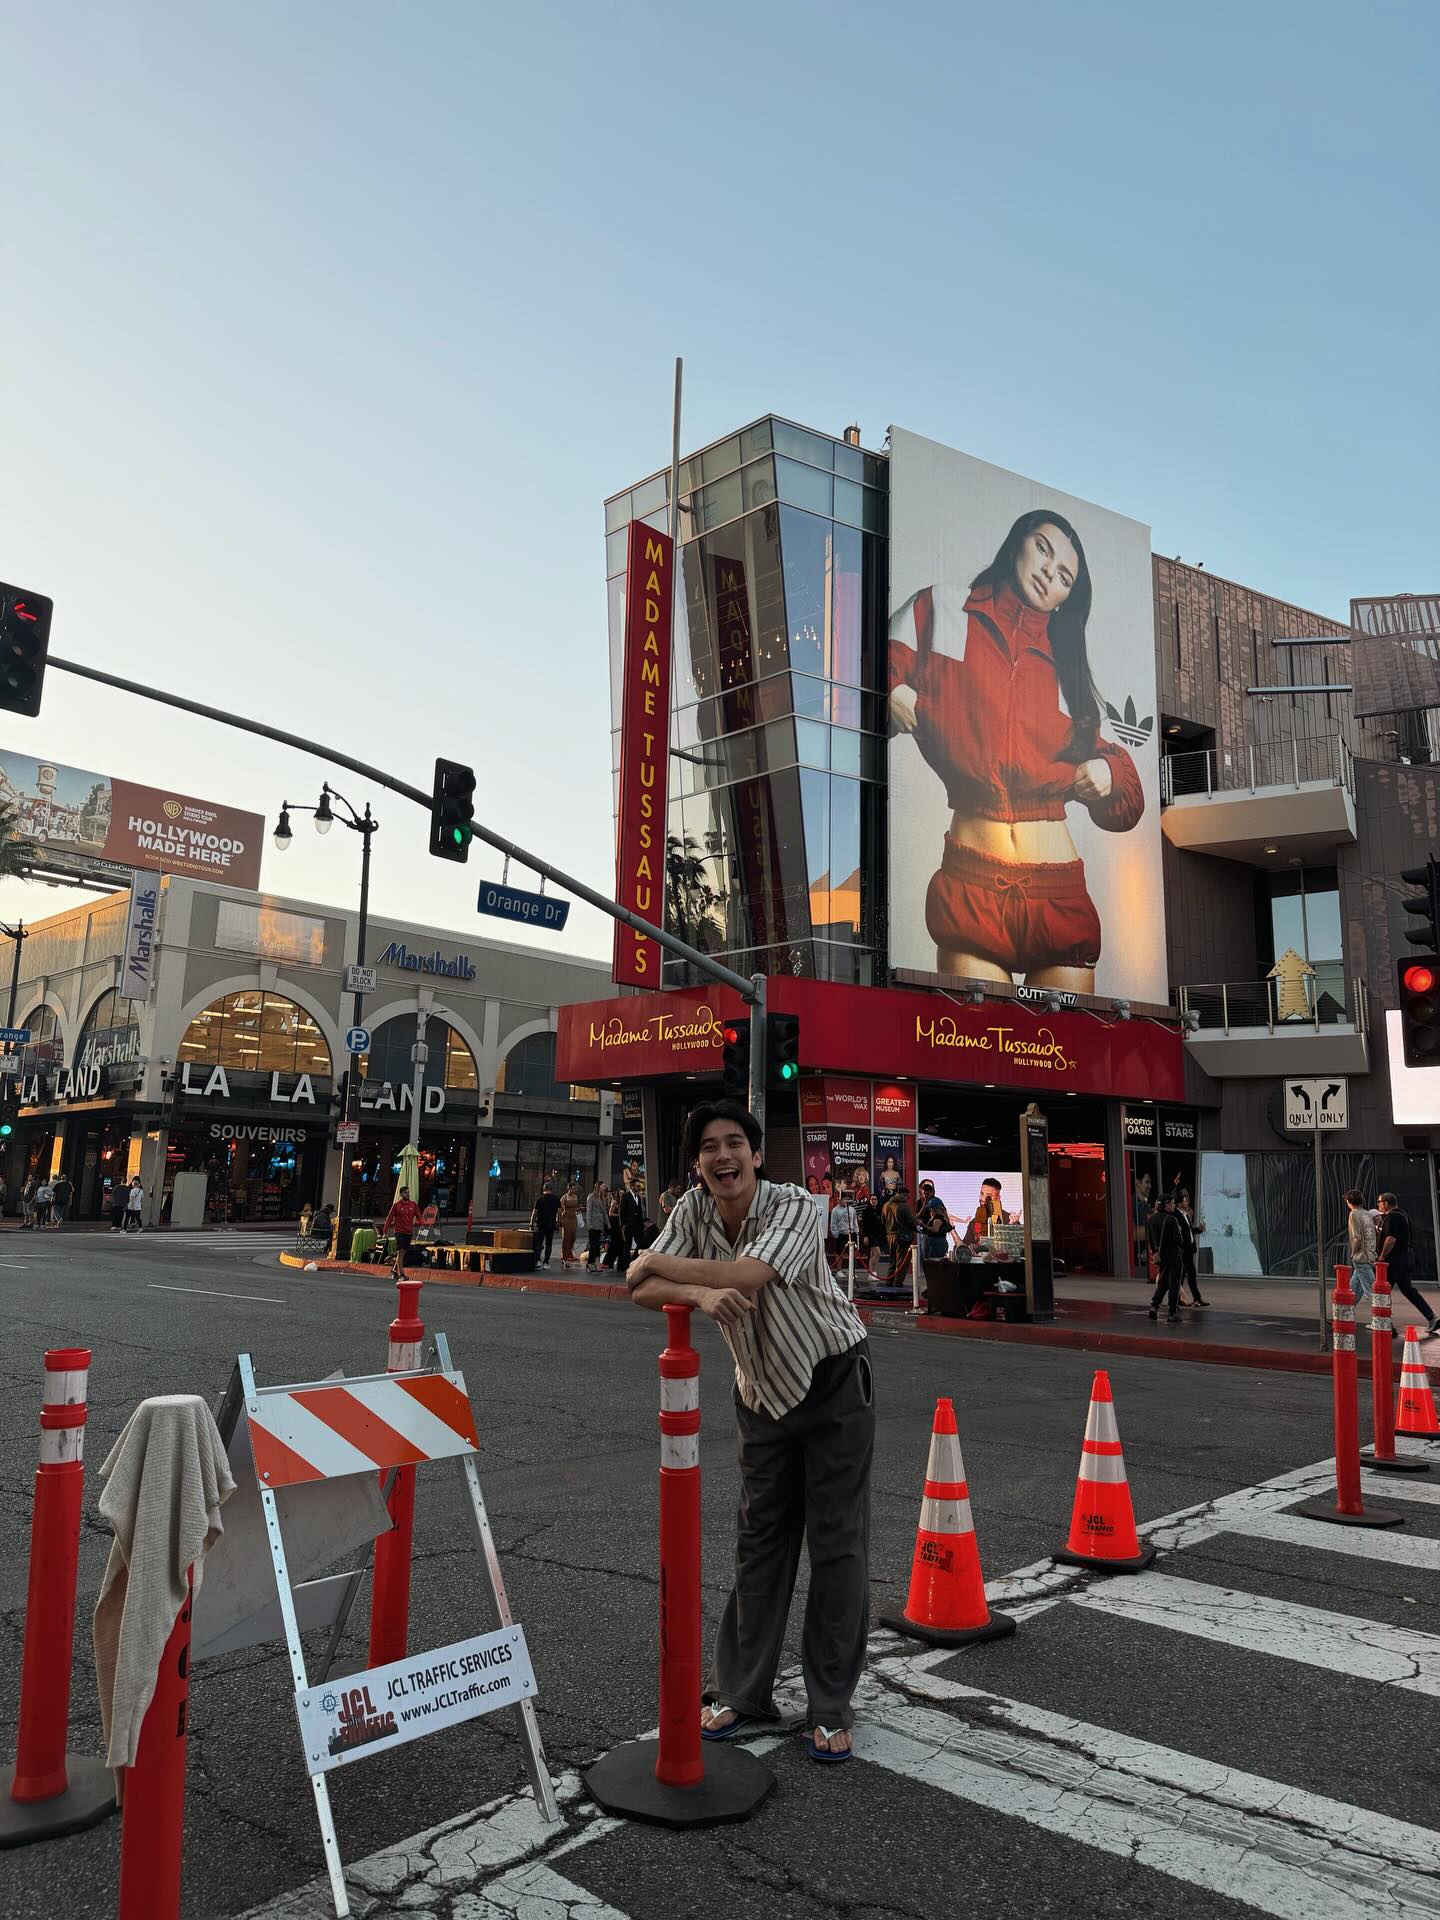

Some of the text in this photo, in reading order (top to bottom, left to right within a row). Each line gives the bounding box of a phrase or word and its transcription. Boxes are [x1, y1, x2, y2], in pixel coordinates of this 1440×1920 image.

[641, 538, 664, 716] MADAME
[128, 816, 244, 854] HOLLYWOOD
[138, 835, 185, 856] MADE
[487, 890, 561, 920] Orange Dr
[129, 889, 157, 981] Marshalls
[376, 942, 477, 980] Marshalls
[351, 967, 374, 977] DO NOT
[352, 976, 371, 985] BLOCK
[0, 1031, 24, 1040] range
[589, 1005, 725, 1050] Madame Tussauds
[80, 1030, 141, 1069] Marshalls
[671, 1040, 709, 1050] HOLLYWOOD
[916, 1015, 1068, 1071] Madame Tussauds
[1013, 1057, 1052, 1069] HOLLYWOOD
[21, 1074, 39, 1104] LA
[55, 1065, 101, 1100] LAND
[182, 1062, 231, 1097] LA
[270, 1071, 316, 1104] LA
[835, 1094, 868, 1104] WORLD'S
[876, 1098, 911, 1107] GREATEST
[1124, 1118, 1155, 1126] ROOFTOP
[1289, 1113, 1344, 1124] ONLY ONLY
[210, 1123, 307, 1142] SOUVENIRS
[845, 1133, 855, 1141] #1
[1127, 1126, 1153, 1136] OASIS
[1165, 1127, 1194, 1138] STARS
[831, 1141, 868, 1152] MUSEUM
[879, 1139, 899, 1147] WAX!
[1087, 1524, 1113, 1532] TRAFFIC
[1088, 1515, 1104, 1524] JCL
[387, 1643, 512, 1700] JCL TRAFFIC SERVICES
[338, 1685, 377, 1724] JCL
[401, 1675, 512, 1723] www.JCLTraffic.com
[338, 1711, 395, 1745] TRAFFIC
